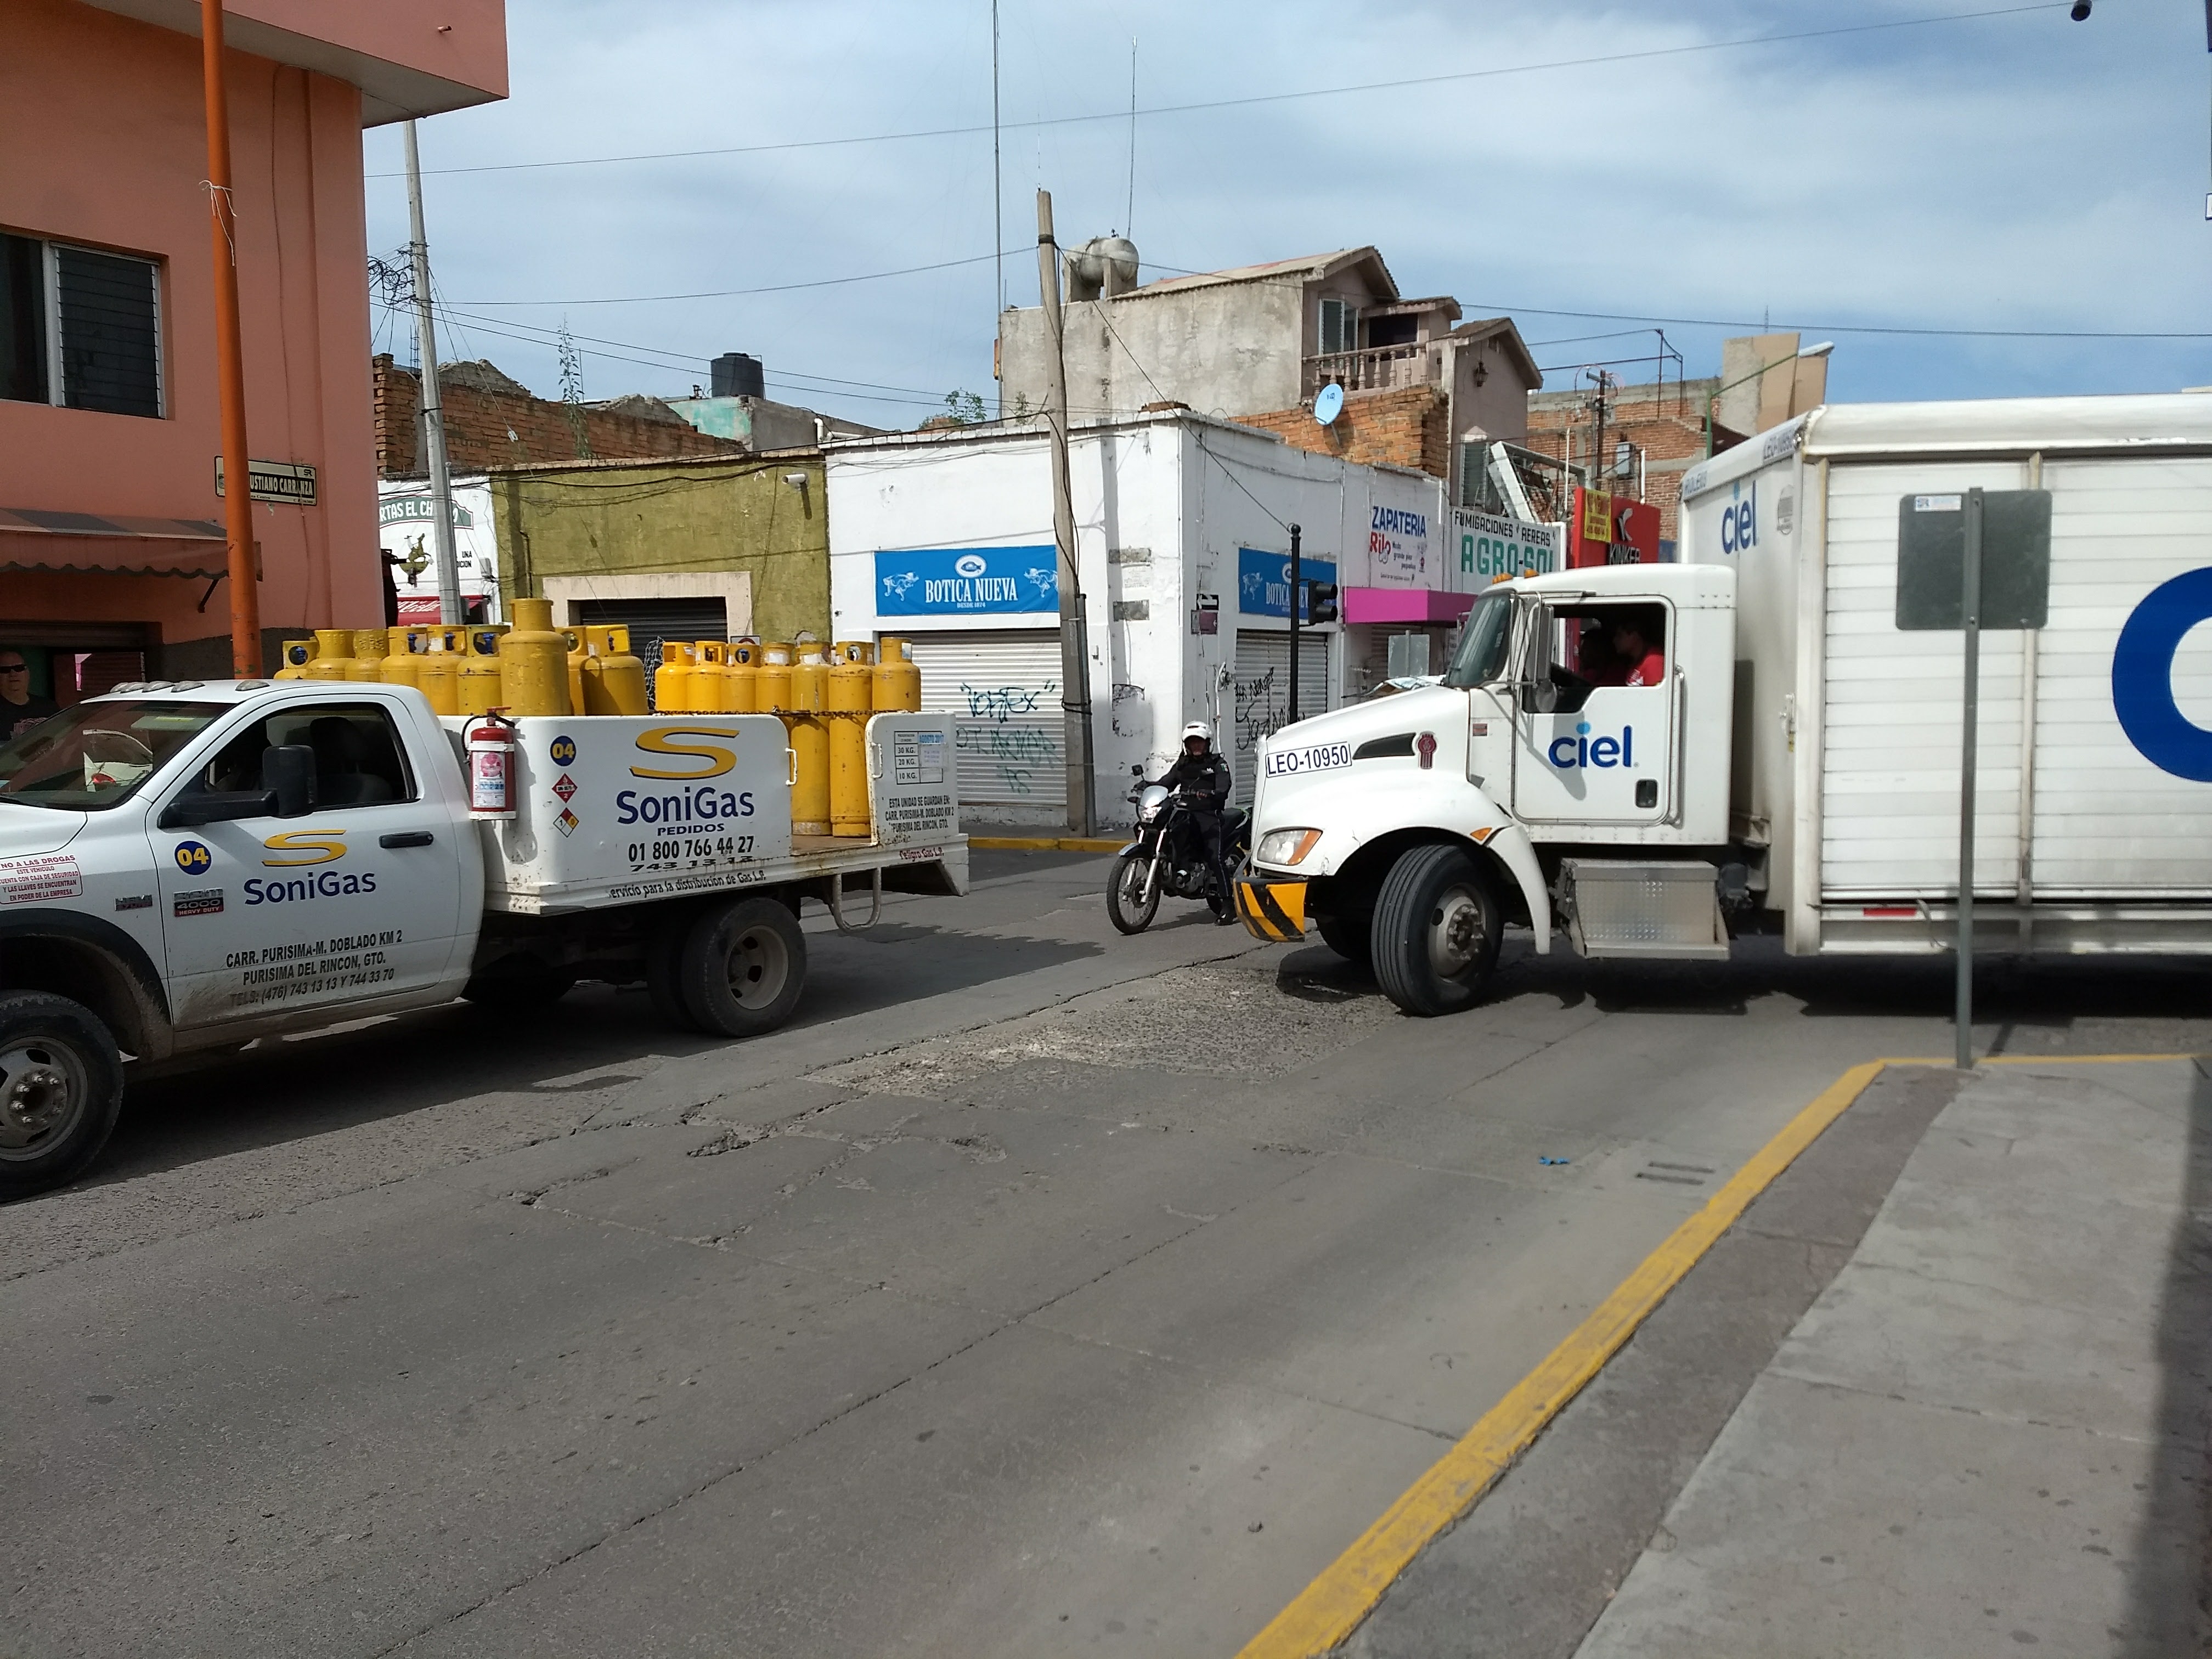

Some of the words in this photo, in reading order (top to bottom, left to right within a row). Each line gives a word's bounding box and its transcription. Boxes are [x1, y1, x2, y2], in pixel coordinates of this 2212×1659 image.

[250, 475, 278, 492] USTIANO
[380, 502, 404, 521] RTAS
[406, 501, 418, 517] EL
[1722, 479, 1757, 555] ciel
[1372, 505, 1426, 538] ZAPATERIA
[1455, 510, 1513, 538] FUMIGACIONES
[925, 579, 972, 603] BOTICA
[975, 577, 1018, 602] NUEVA
[1266, 582, 1290, 606] BOTICA
[551, 743, 575, 759] 04
[1548, 720, 1633, 768] ciel
[1267, 745, 1348, 775] LEO-10950
[616, 786, 755, 825] SoniGas
[889, 797, 900, 808] ESTA
[901, 796, 917, 807] UNIDAD
[917, 796, 923, 806] SE
[924, 795, 943, 806] GUARDAN
[926, 807, 944, 818] DOBLADO
[945, 807, 951, 816] KM
[951, 806, 954, 816] 2
[657, 823, 725, 836] PEDIDOS
[913, 822, 922, 831] DEL
[177, 847, 209, 867] 04
[628, 843, 646, 862] 01
[652, 840, 680, 860] 800
[685, 839, 712, 857] 766
[716, 837, 734, 855] 44
[737, 836, 754, 853] 27
[922, 848, 934, 857] Gas
[41, 855, 76, 864] DROGAS
[630, 862, 678, 872] 743
[689, 858, 716, 867] 13
[18, 883, 36, 891] LLAVES
[44, 879, 77, 889] ENCUENTRAN
[51, 871, 78, 879] SEGURIDAD
[50, 889, 72, 897] EMPRESA
[244, 871, 377, 906] SoniGas
[608, 884, 642, 899] ervicio
[644, 883, 664, 898] para
[665, 880, 674, 892] la
[727, 874, 736, 885] de
[737, 872, 753, 883] Gas
[177, 899, 221, 910] 4000
[225, 948, 259, 968] CARR.
[330, 933, 376, 953] DOBLADO
[379, 931, 394, 946] KM
[396, 929, 403, 943] 2
[243, 964, 295, 986] PURISIMA
[297, 961, 317, 977] DEL
[319, 955, 361, 973] RINCON,
[364, 951, 386, 967] GTO.
[261, 985, 287, 1005] (476)
[290, 981, 308, 997] 743
[311, 979, 323, 994] 13
[326, 977, 337, 991] 13
[341, 975, 348, 989] Y
[349, 972, 367, 987] 744
[369, 970, 381, 984] 33
[382, 967, 396, 981] 70
